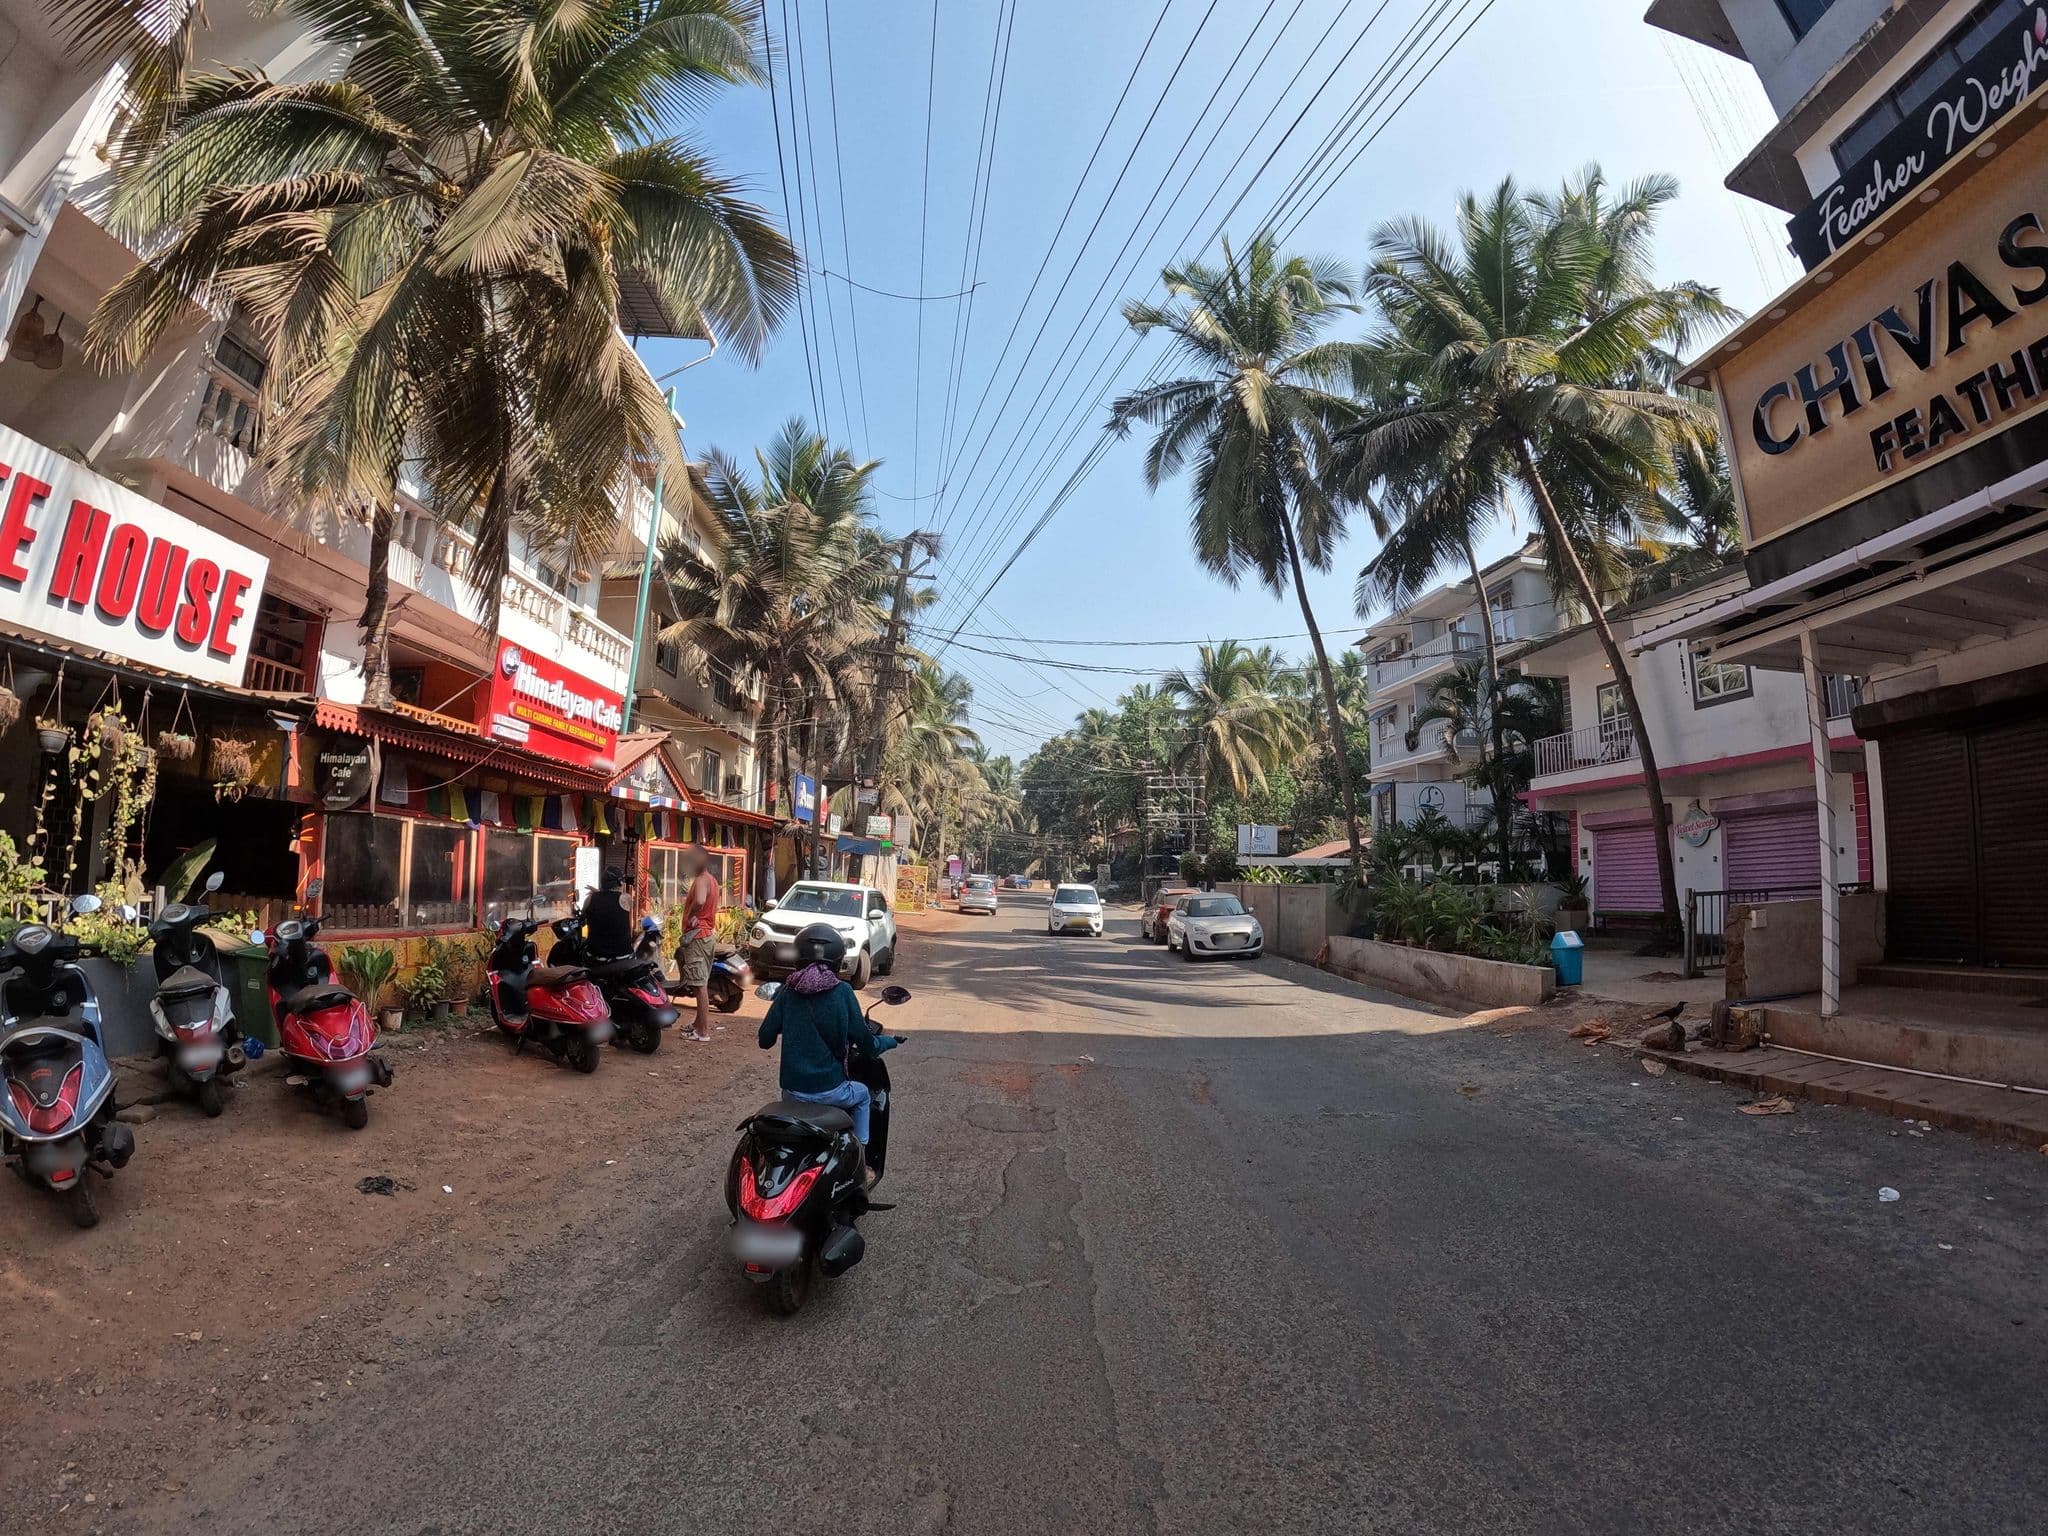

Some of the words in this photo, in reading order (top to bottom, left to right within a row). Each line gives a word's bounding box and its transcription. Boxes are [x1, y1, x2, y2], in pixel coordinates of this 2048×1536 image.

[1818, 150, 1925, 253] Feather
[1752, 212, 2048, 456] CHIVAS
[49, 499, 253, 658] HOUSE
[514, 662, 593, 719] Himalayan
[592, 698, 622, 731] Cafe
[320, 752, 367, 766] Himalayan
[331, 766, 352, 778] Cafe
